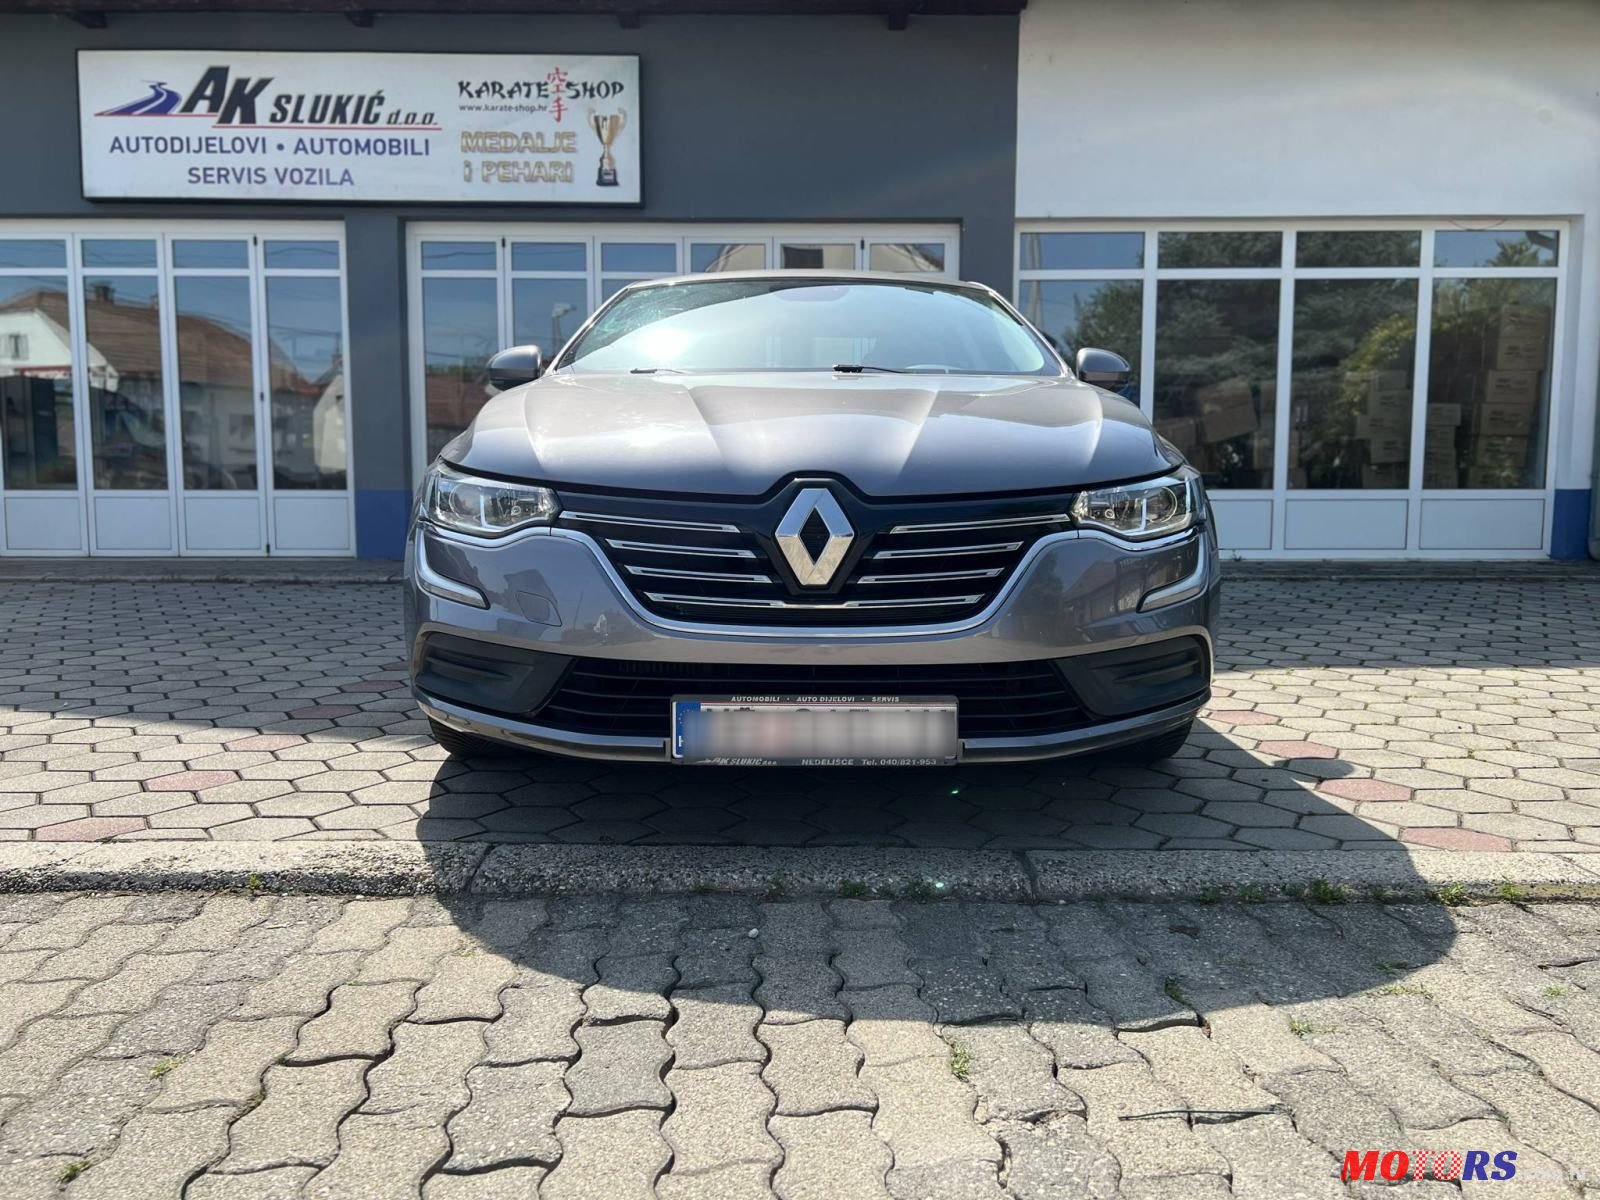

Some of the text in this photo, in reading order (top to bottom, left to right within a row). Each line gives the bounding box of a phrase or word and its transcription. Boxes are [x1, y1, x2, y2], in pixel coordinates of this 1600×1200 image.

[179, 65, 439, 126] AK SLUKIĆ d.o.o.
[458, 80, 625, 99] KARATE SHOP
[459, 103, 548, 114] www.karate-shop.hr
[110, 136, 431, 156] AUTODIJELOVI AUTOMOBILI
[460, 131, 577, 154] MEDALJE
[187, 167, 355, 187] SERVIS VOZILA
[481, 161, 575, 184] PEHARI
